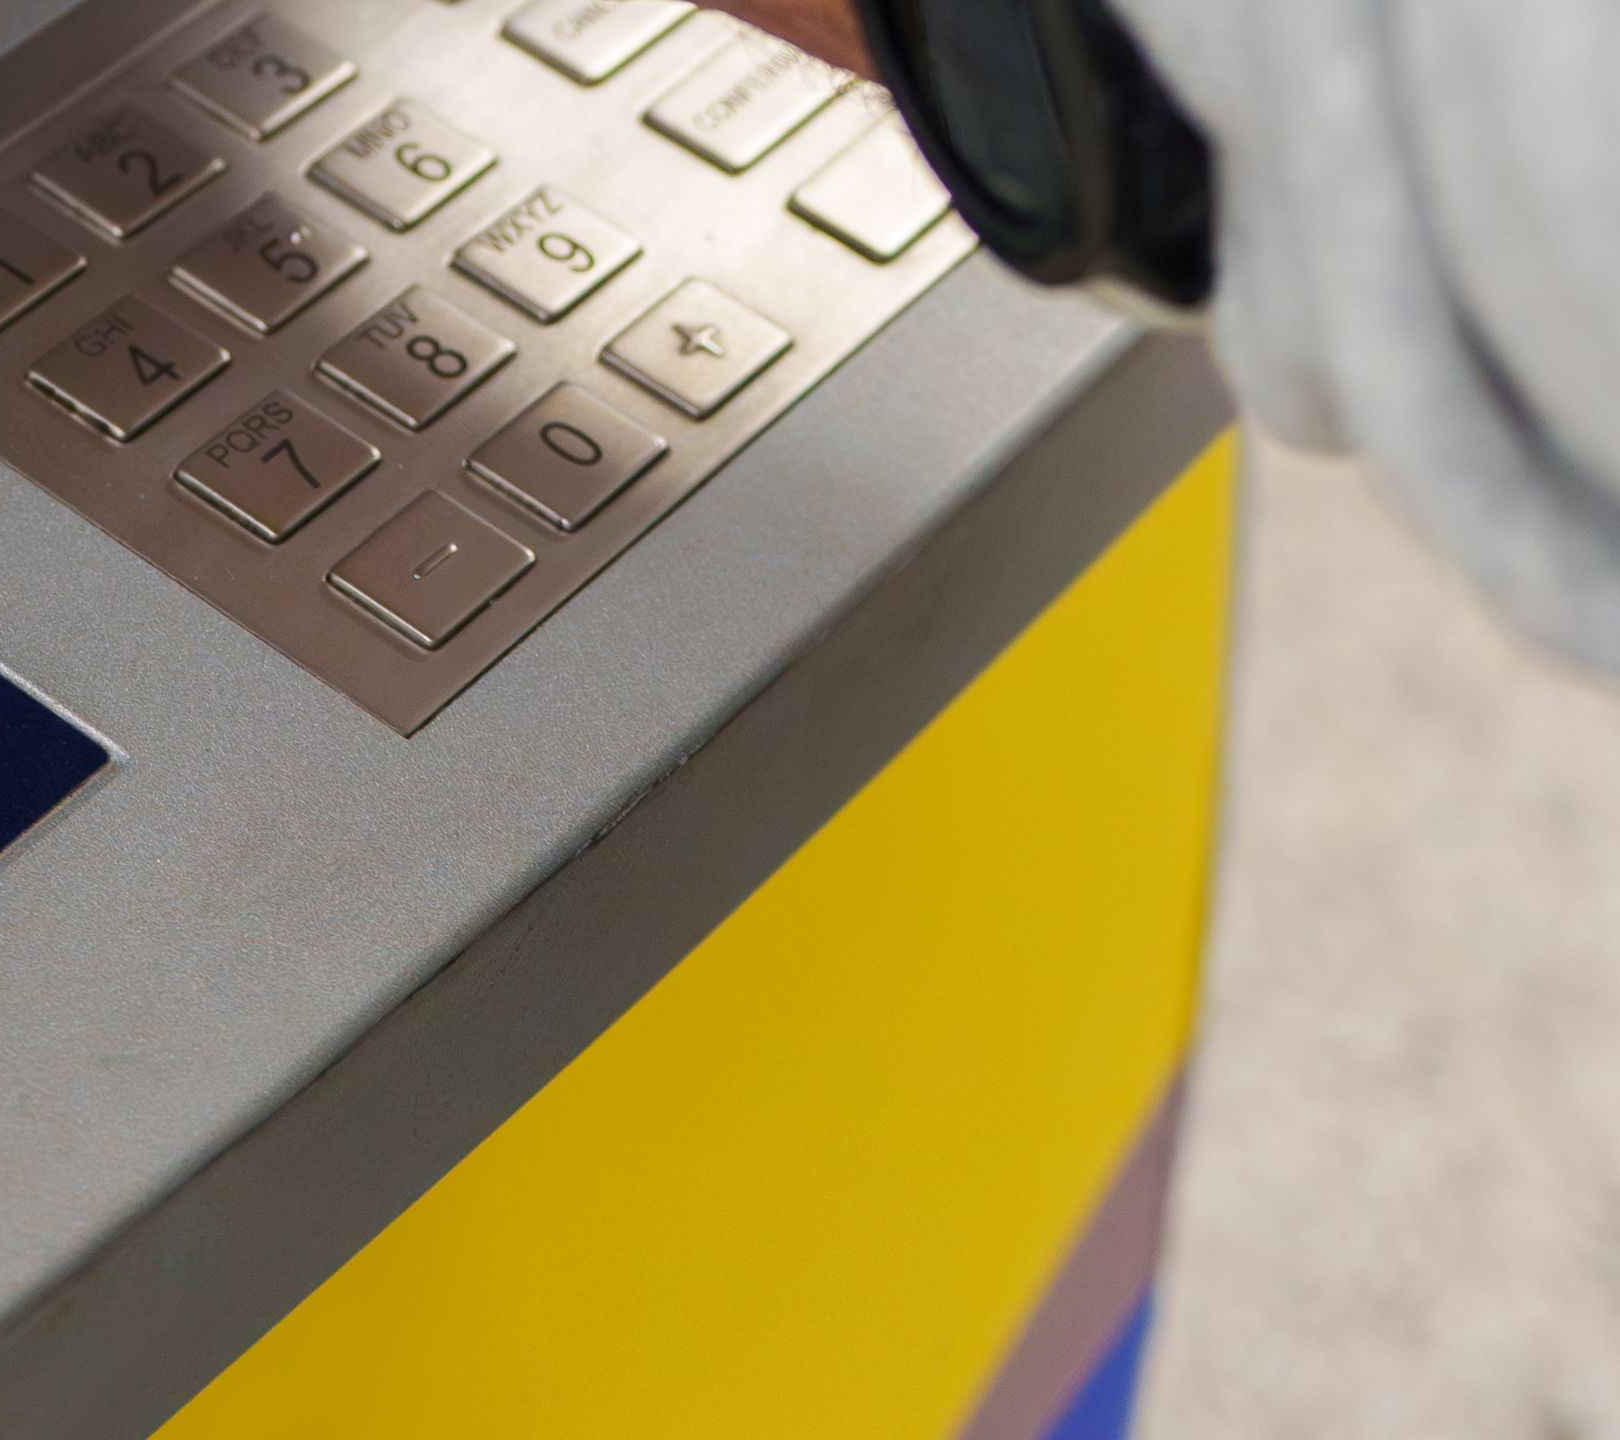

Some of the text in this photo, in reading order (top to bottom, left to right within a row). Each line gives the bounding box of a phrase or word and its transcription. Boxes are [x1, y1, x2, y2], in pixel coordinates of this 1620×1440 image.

[249, 52, 311, 95] 3
[118, 149, 183, 195] 2
[394, 143, 453, 183] 6
[474, 191, 564, 253] WXYZ
[259, 238, 318, 284] 5
[537, 231, 596, 274] 9
[74, 314, 135, 358] GHI
[357, 301, 420, 349] TUV
[128, 344, 183, 386] 4
[406, 334, 468, 379] 8
[206, 400, 294, 469] PQRS
[538, 420, 604, 467] 0
[260, 437, 321, 490] 7
